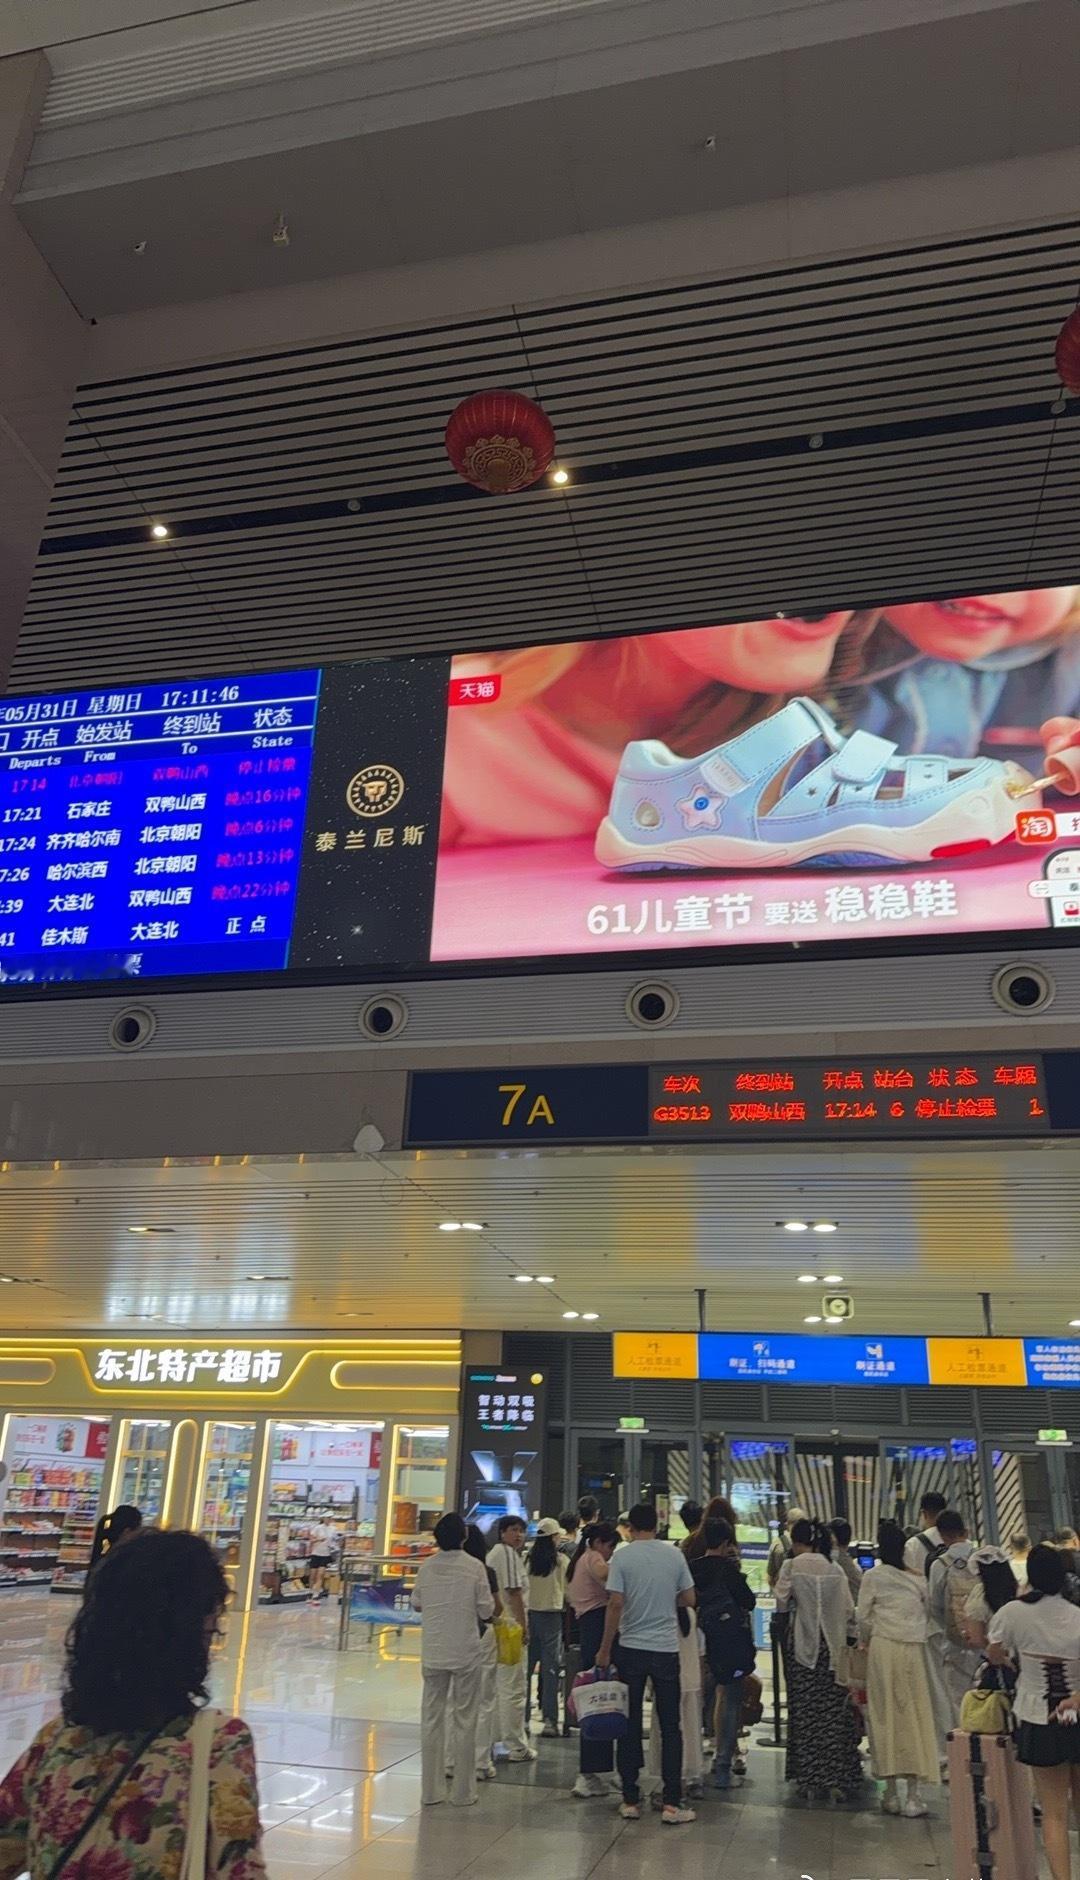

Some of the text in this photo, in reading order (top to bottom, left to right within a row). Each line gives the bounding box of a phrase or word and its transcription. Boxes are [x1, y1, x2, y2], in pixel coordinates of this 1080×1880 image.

[86, 693, 142, 714] 星期日
[161, 686, 239, 707] 17:11:46
[459, 681, 494, 700] 天猫
[21, 728, 60, 749] 开点
[75, 720, 133, 744] 始发站
[162, 712, 222, 735] 终到站
[253, 706, 293, 728] 状态
[8, 736, 293, 770] Departs From To State
[3, 807, 42, 823] 17:21
[67, 800, 112, 819] 石家庄
[144, 793, 207, 813] 双鸭山西
[0, 836, 36, 852] 17:24
[46, 829, 122, 850] 齐齐哈尔南
[139, 823, 202, 844] 北京朝阳
[315, 825, 426, 852] 泰兰尼斯
[1020, 816, 1053, 838] 淘
[46, 861, 109, 880] 哈尔滨西
[133, 854, 197, 875] 北京朝阳
[47, 893, 95, 912] 大连北
[128, 887, 193, 907] 双鸭山西
[586, 879, 960, 935] 61儿童节 要送 稳稳鞋
[41, 926, 89, 946] 佳木斯
[130, 920, 179, 941] 大连北
[663, 1075, 701, 1094] 车次
[735, 1073, 794, 1091] 终到站
[823, 1071, 864, 1090] 开点
[874, 1069, 914, 1089] 站台
[928, 1067, 979, 1087] 状态
[499, 1084, 554, 1126] 7A
[653, 1097, 1044, 1122] G3513 双鸭山西 17:14 6 停止检票 1
[94, 1348, 283, 1383] 东北特产超市
